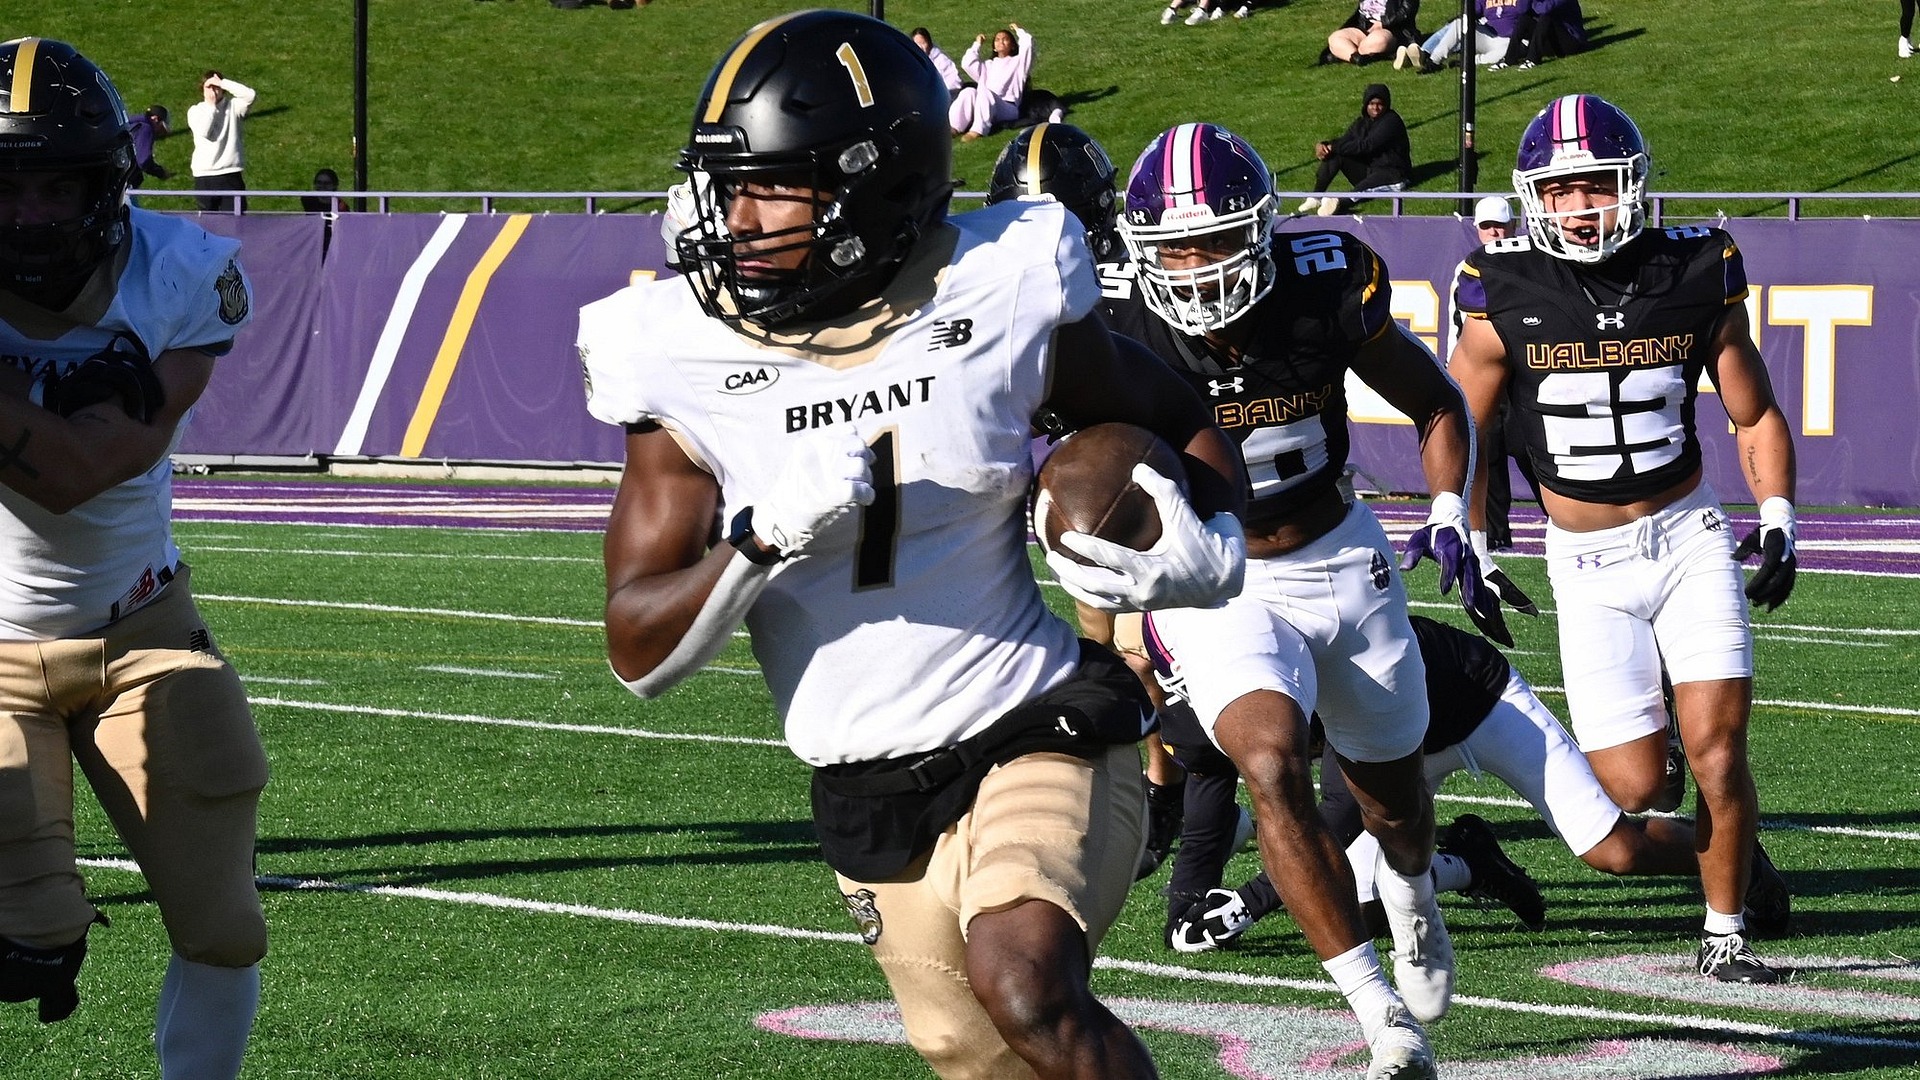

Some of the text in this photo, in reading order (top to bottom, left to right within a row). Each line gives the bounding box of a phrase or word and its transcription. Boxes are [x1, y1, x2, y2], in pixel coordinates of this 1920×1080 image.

[835, 41, 875, 109] 1
[1290, 233, 1348, 276] 20
[1526, 333, 1694, 370] UALBANY
[724, 368, 770, 391] CAA
[785, 376, 936, 434] BRYANT
[1213, 383, 1332, 429] BANY
[1536, 364, 1688, 482] 23
[851, 423, 903, 594] 1
